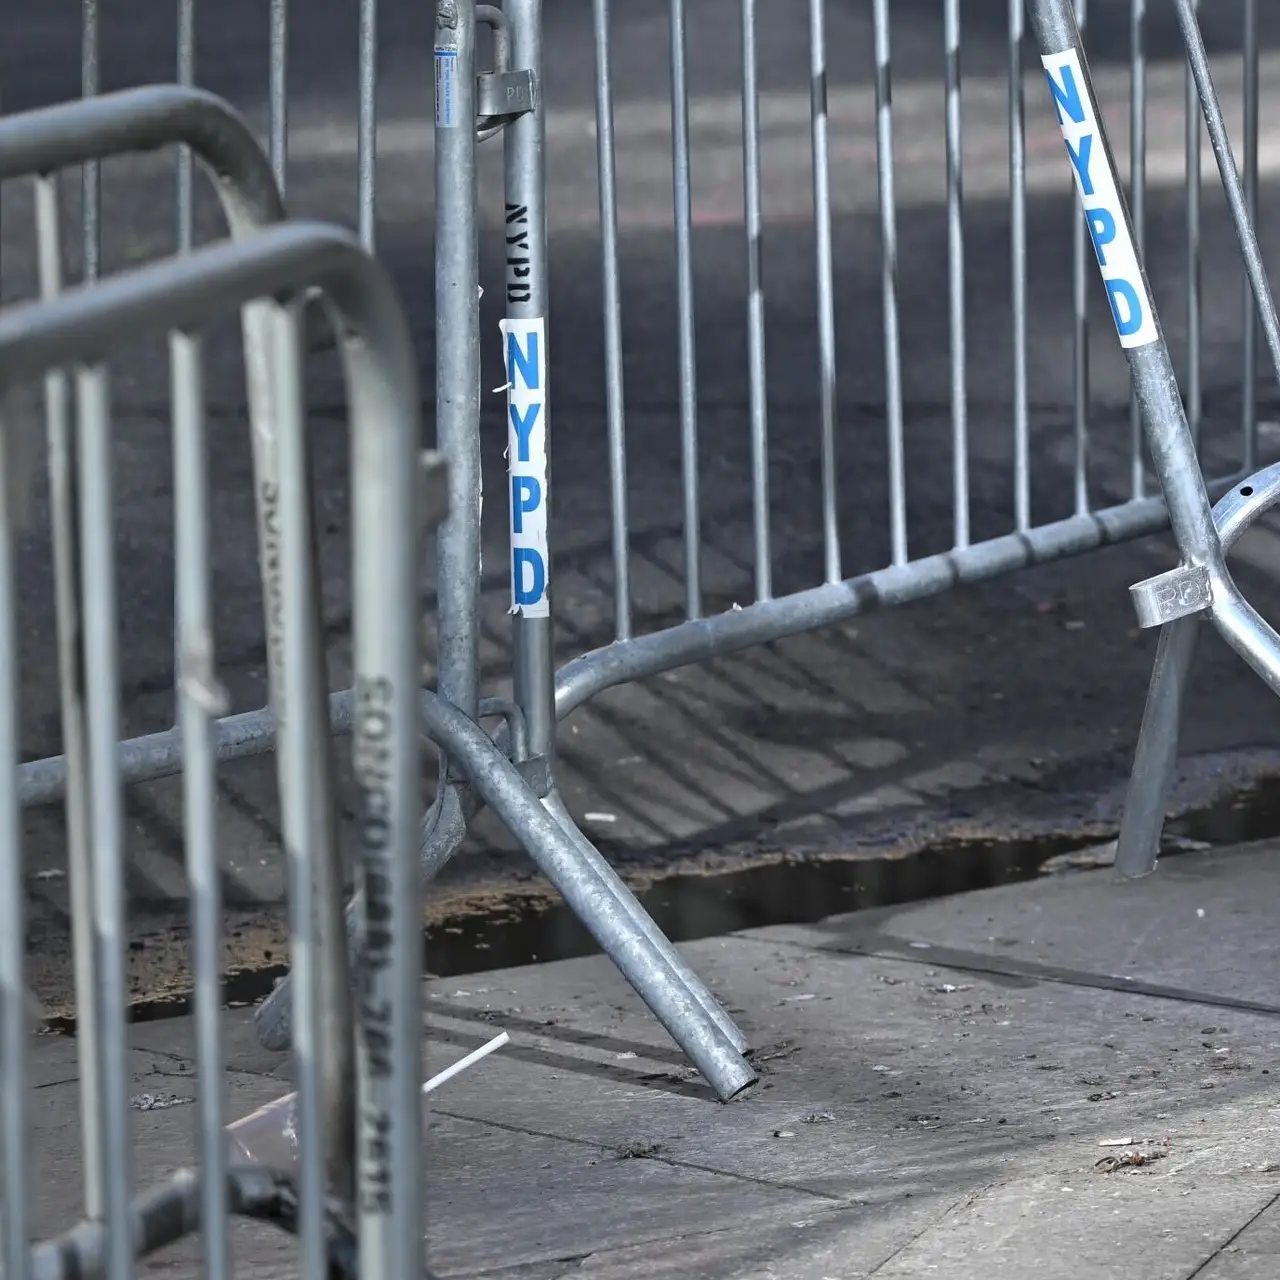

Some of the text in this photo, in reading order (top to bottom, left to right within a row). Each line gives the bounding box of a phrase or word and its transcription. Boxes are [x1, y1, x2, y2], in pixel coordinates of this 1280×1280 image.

[505, 203, 531, 303] NYPD
[1045, 65, 1142, 336] NYPD
[506, 331, 546, 606] NYPD
